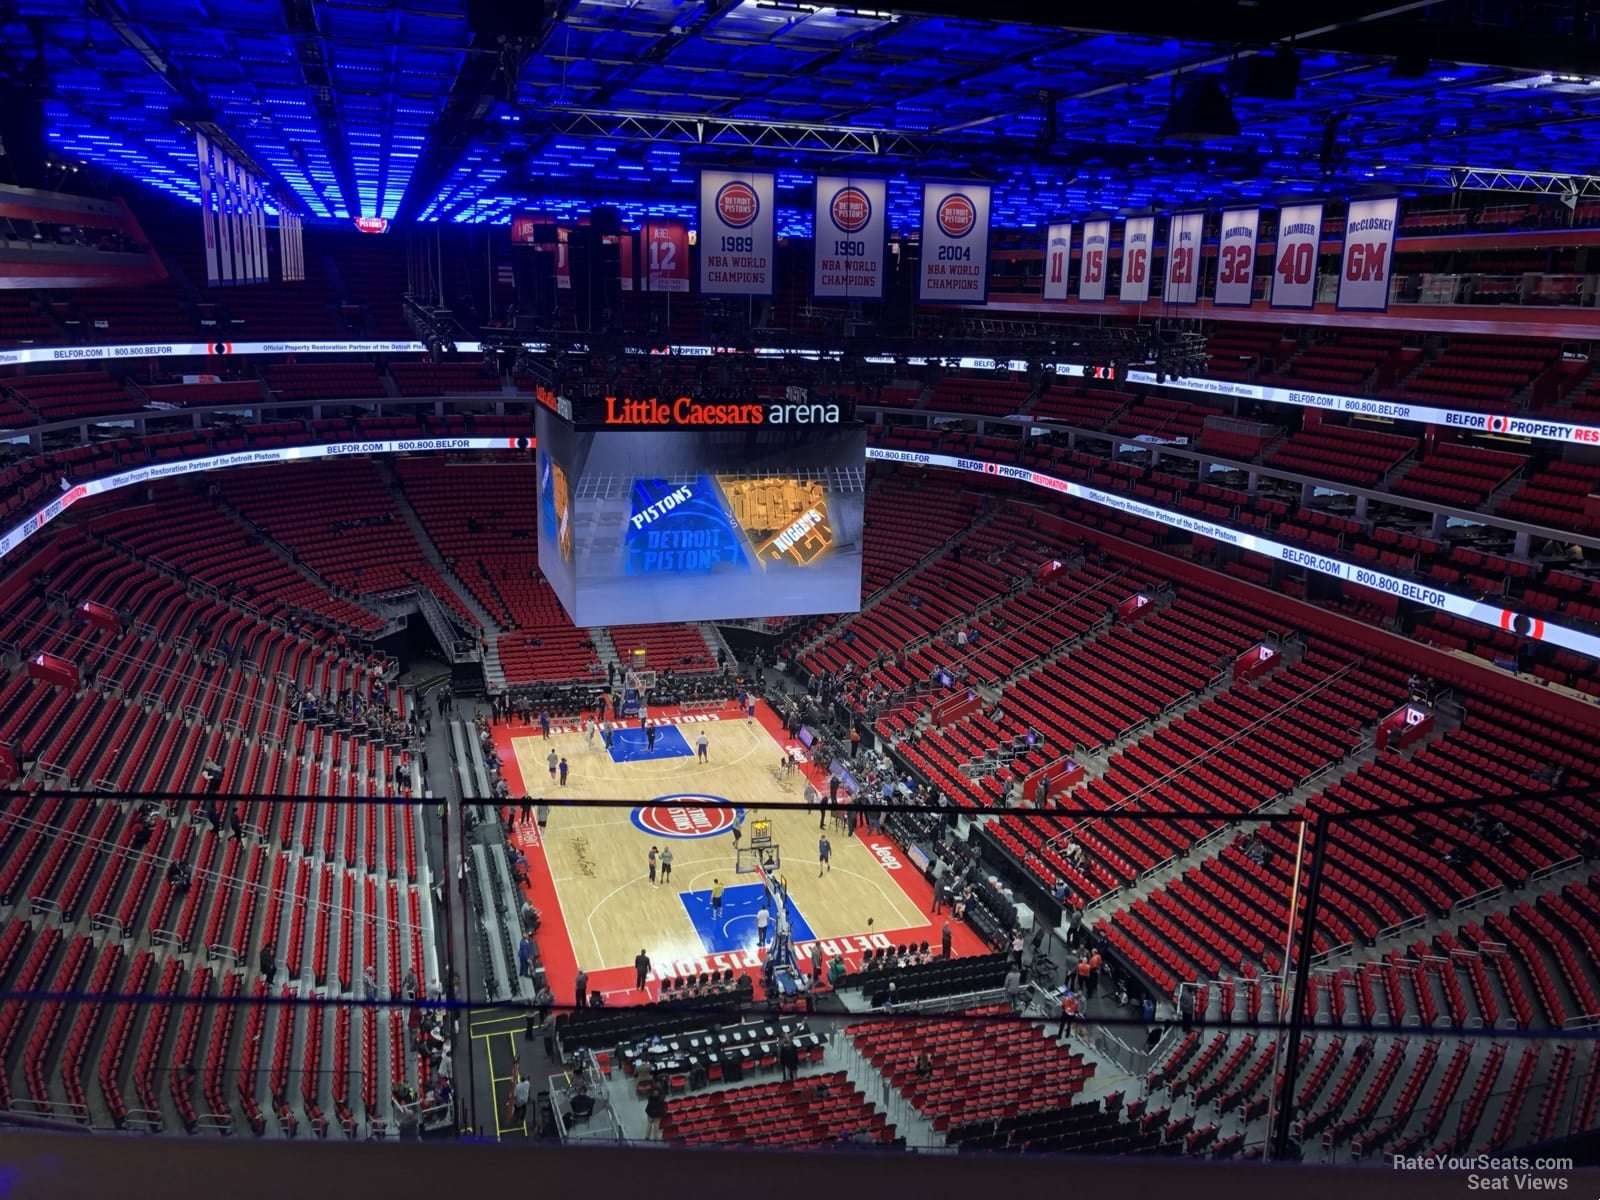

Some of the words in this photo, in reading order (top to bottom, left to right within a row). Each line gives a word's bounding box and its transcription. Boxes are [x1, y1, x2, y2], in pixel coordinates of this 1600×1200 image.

[725, 197, 750, 205] DETROIT
[725, 205, 751, 213] PISTONS
[838, 203, 863, 211] DETROIT
[838, 210, 864, 218] PISTONS
[945, 208, 969, 216] DETROIT
[945, 216, 969, 224] PISTONS
[1225, 227, 1252, 240] HAMILTON
[1283, 223, 1315, 237] LAIMBEER
[1349, 218, 1393, 234] McCLOSKEY
[721, 236, 753, 252] 1989
[834, 241, 865, 256] 1990
[650, 241, 676, 270] 12
[938, 246, 971, 261] 2004
[708, 256, 729, 268] NBA
[732, 257, 766, 269] WORLD
[822, 260, 842, 271] NBA
[844, 261, 877, 272] WORLD
[928, 264, 946, 275] NBA
[949, 265, 980, 276] WORLD
[1051, 252, 1063, 283] 11
[1085, 251, 1103, 283] 15
[1126, 249, 1146, 283] 16
[1172, 247, 1193, 283] 21
[1220, 245, 1252, 284] 32
[1277, 243, 1314, 284] 40
[1346, 243, 1387, 281] GM
[708, 271, 765, 283] CHAMPIONS
[822, 274, 876, 286] CHAMPIONS
[927, 278, 979, 290] CHAMPIONS
[54, 348, 103, 359] BELFOR.COM
[114, 346, 173, 356] 800.800.BELFOR
[285, 344, 310, 352] Property
[605, 396, 670, 424] Little
[673, 396, 764, 425] Caesars
[768, 403, 840, 424] arena
[1289, 392, 1333, 407] BELFOR.COM
[1345, 400, 1410, 417] 800.800.BELFOR
[1446, 413, 1485, 428] BELFOR
[1510, 421, 1572, 439] PROPERTY
[327, 443, 384, 454] BELFOR.COM
[398, 439, 470, 450] 800.800.BELFOR
[150, 464, 188, 477] Restoration
[189, 460, 211, 471] Partner
[230, 455, 252, 464] Detroit
[254, 452, 281, 461] Pistons
[869, 450, 930, 463] 800.800.BELFOR
[957, 459, 984, 471] BELFOR
[999, 466, 1032, 481] PROPERTY
[631, 485, 693, 530] PISTONS
[1089, 491, 1106, 503] Official
[1106, 496, 1126, 510] Property
[1126, 503, 1155, 518] Restoration
[1156, 511, 1176, 524] Partner
[1176, 517, 1183, 526] of
[1183, 518, 1193, 529] the
[1193, 522, 1214, 535] Detroit
[1214, 527, 1237, 543] Pistons
[648, 528, 720, 549] DETROIT
[773, 509, 822, 553] NUGGETS
[1282, 548, 1341, 575] BELFOR.COM
[1356, 570, 1446, 608] 800.800.BELFOR
[871, 843, 902, 870] Jeep
